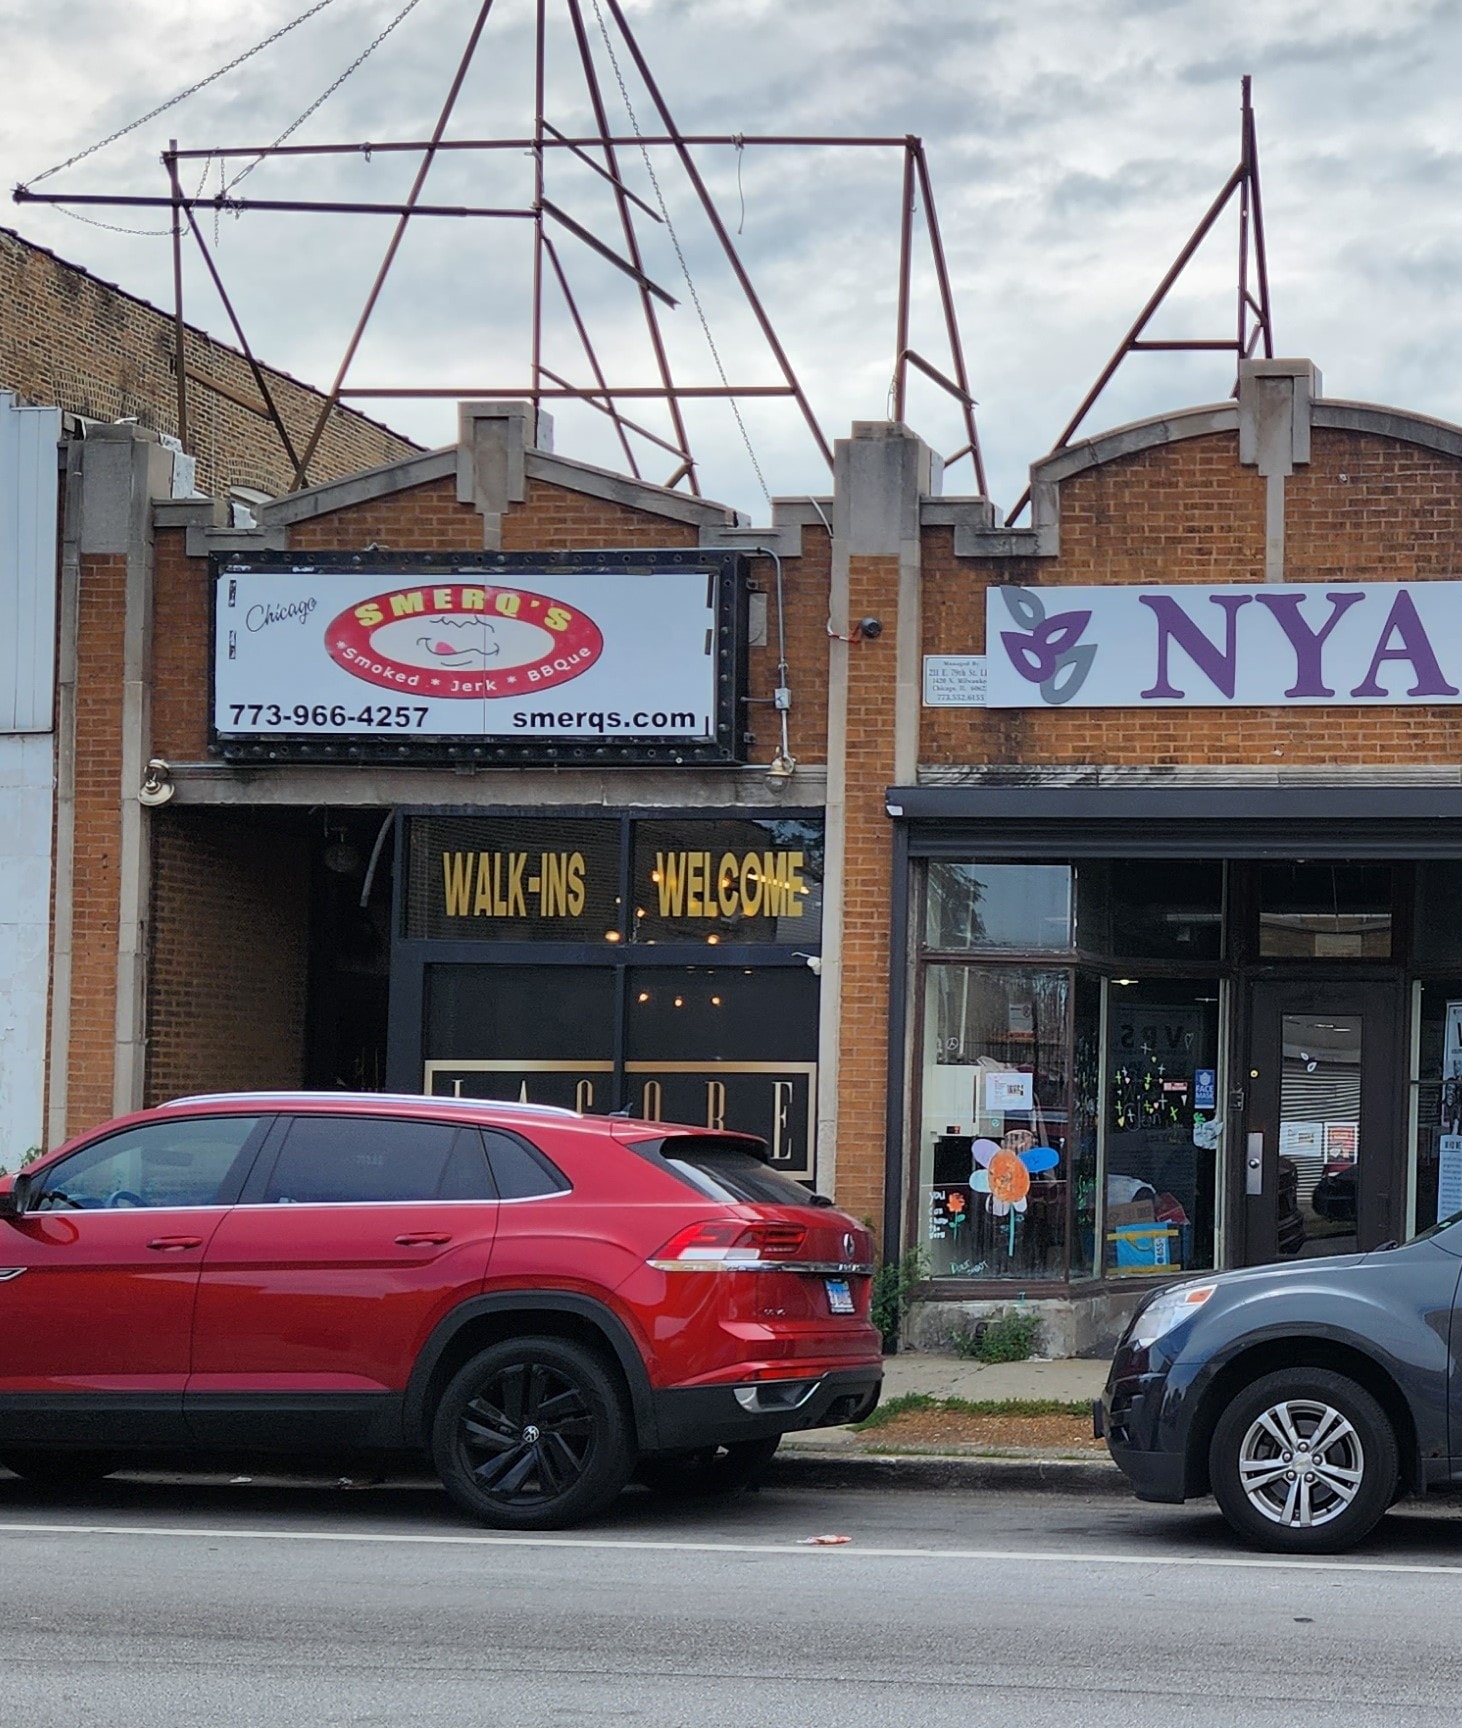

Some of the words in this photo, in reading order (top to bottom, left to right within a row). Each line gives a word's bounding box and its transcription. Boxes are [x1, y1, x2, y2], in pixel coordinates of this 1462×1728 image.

[246, 597, 318, 632] Chicago
[354, 588, 572, 631] SMERQ'S
[342, 648, 420, 686] Smoked
[451, 679, 497, 692] Jerk
[527, 647, 591, 681] BBQue
[229, 704, 429, 728] 773-966-4257
[512, 708, 697, 733] smerqs.com
[443, 850, 586, 918] WALK-INS
[656, 850, 804, 918] WELCOME
